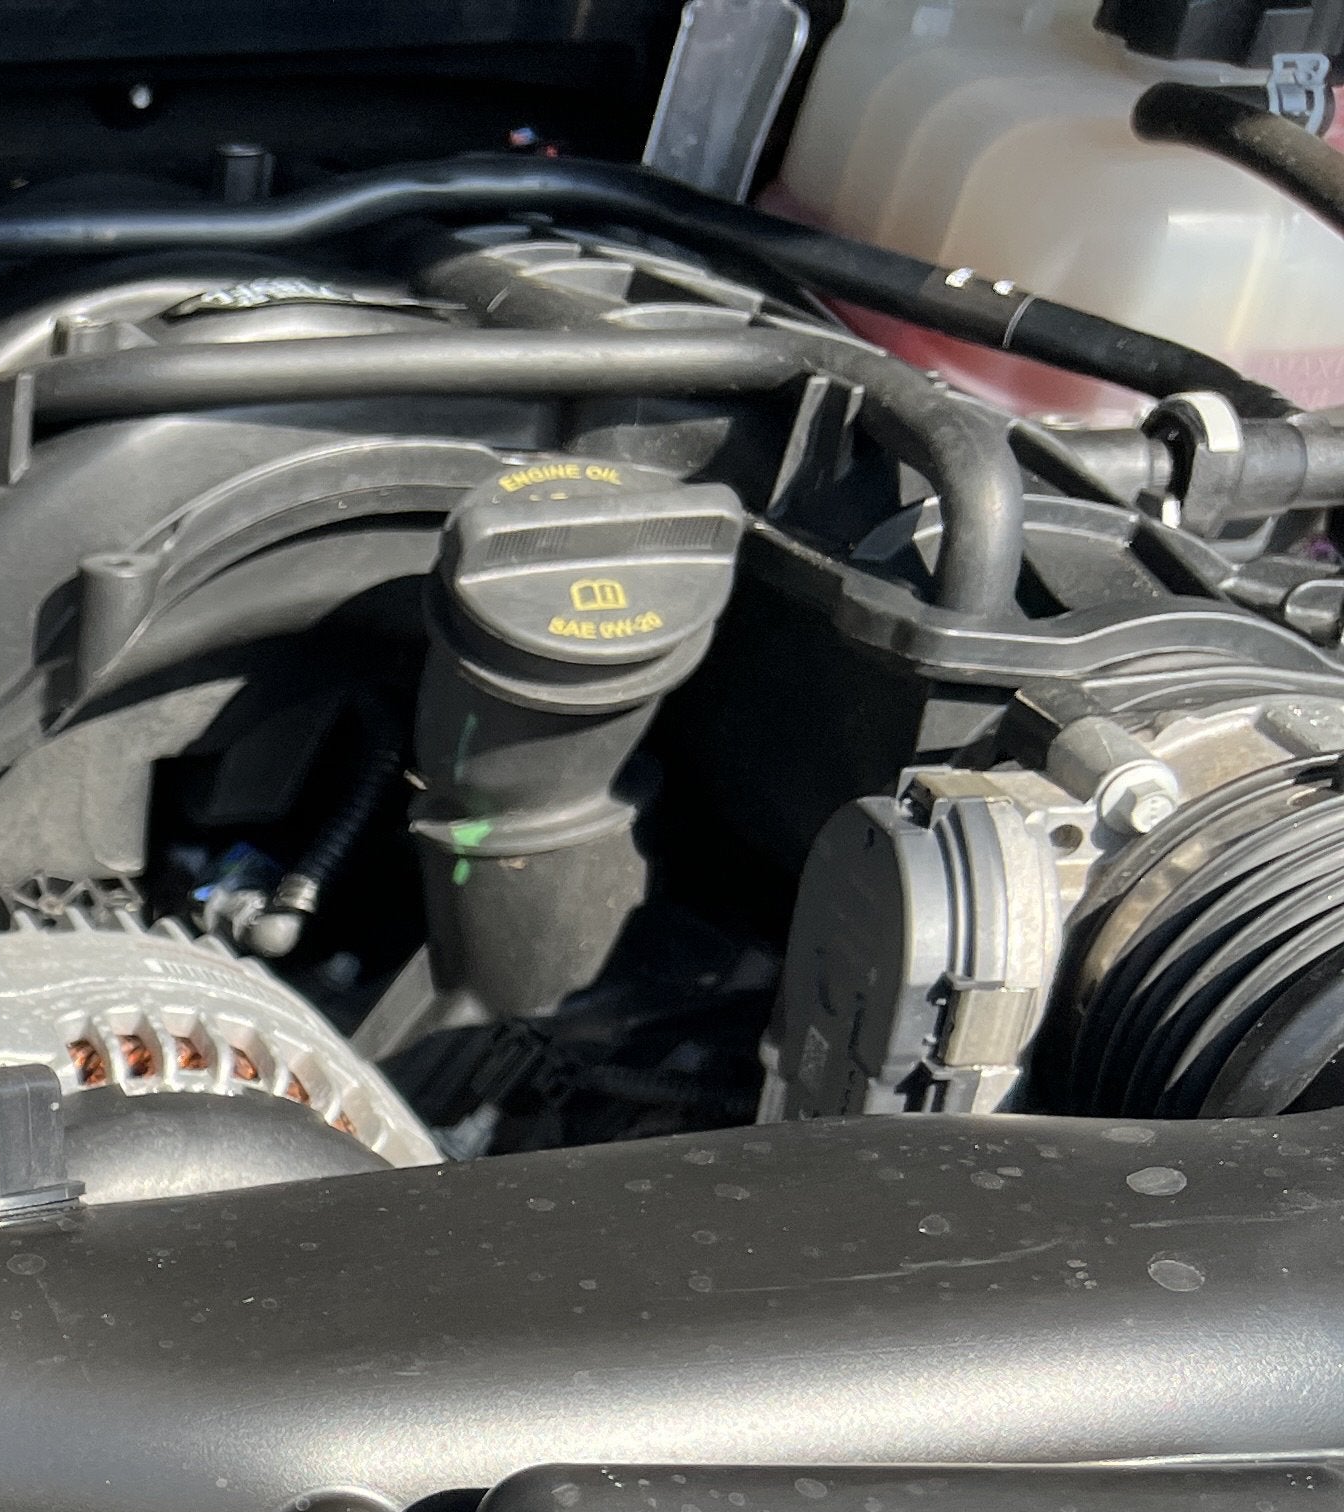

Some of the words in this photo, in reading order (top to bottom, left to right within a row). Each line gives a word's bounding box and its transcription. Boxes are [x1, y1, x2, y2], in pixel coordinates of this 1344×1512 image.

[499, 464, 582, 492] ENGINE
[585, 465, 623, 485] OIL
[548, 616, 597, 639] SAE
[599, 611, 663, 639] 0W-20
